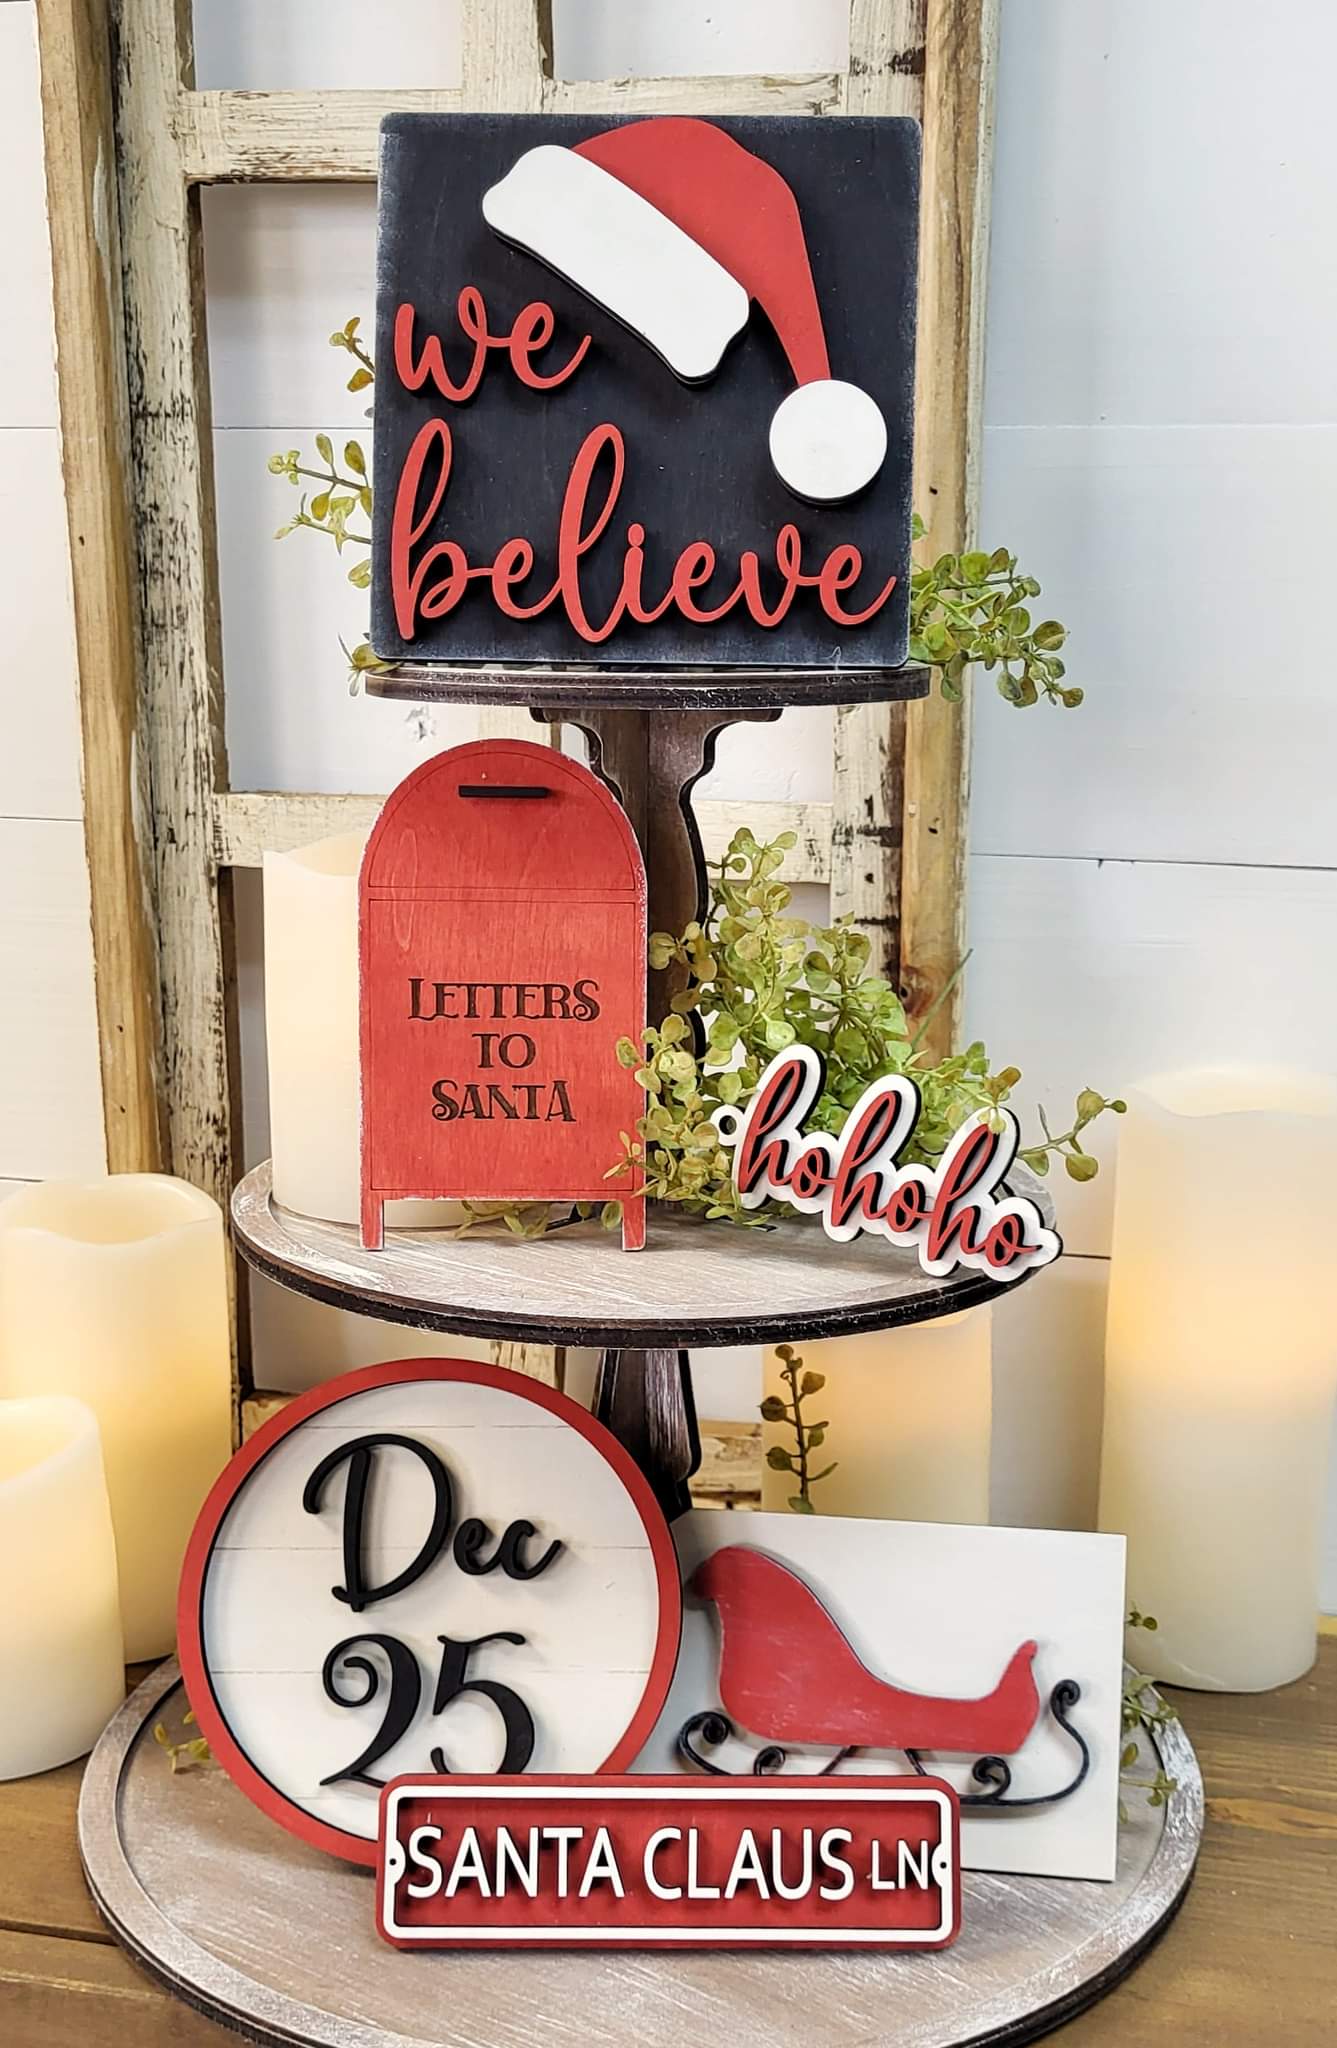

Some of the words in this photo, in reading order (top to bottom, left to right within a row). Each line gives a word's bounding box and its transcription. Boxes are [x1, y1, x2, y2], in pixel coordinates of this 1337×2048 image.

[395, 286, 592, 401] we
[391, 418, 898, 644] believe
[408, 978, 600, 1022] LETTERS
[472, 1033, 537, 1069] TO
[431, 1079, 576, 1122] SANTA
[303, 1433, 566, 1613] Dec
[319, 1631, 535, 1788] 25
[407, 1825, 624, 1898] SANTA
[643, 1826, 855, 1900] CLAUS
[871, 1839, 929, 1890] LN
